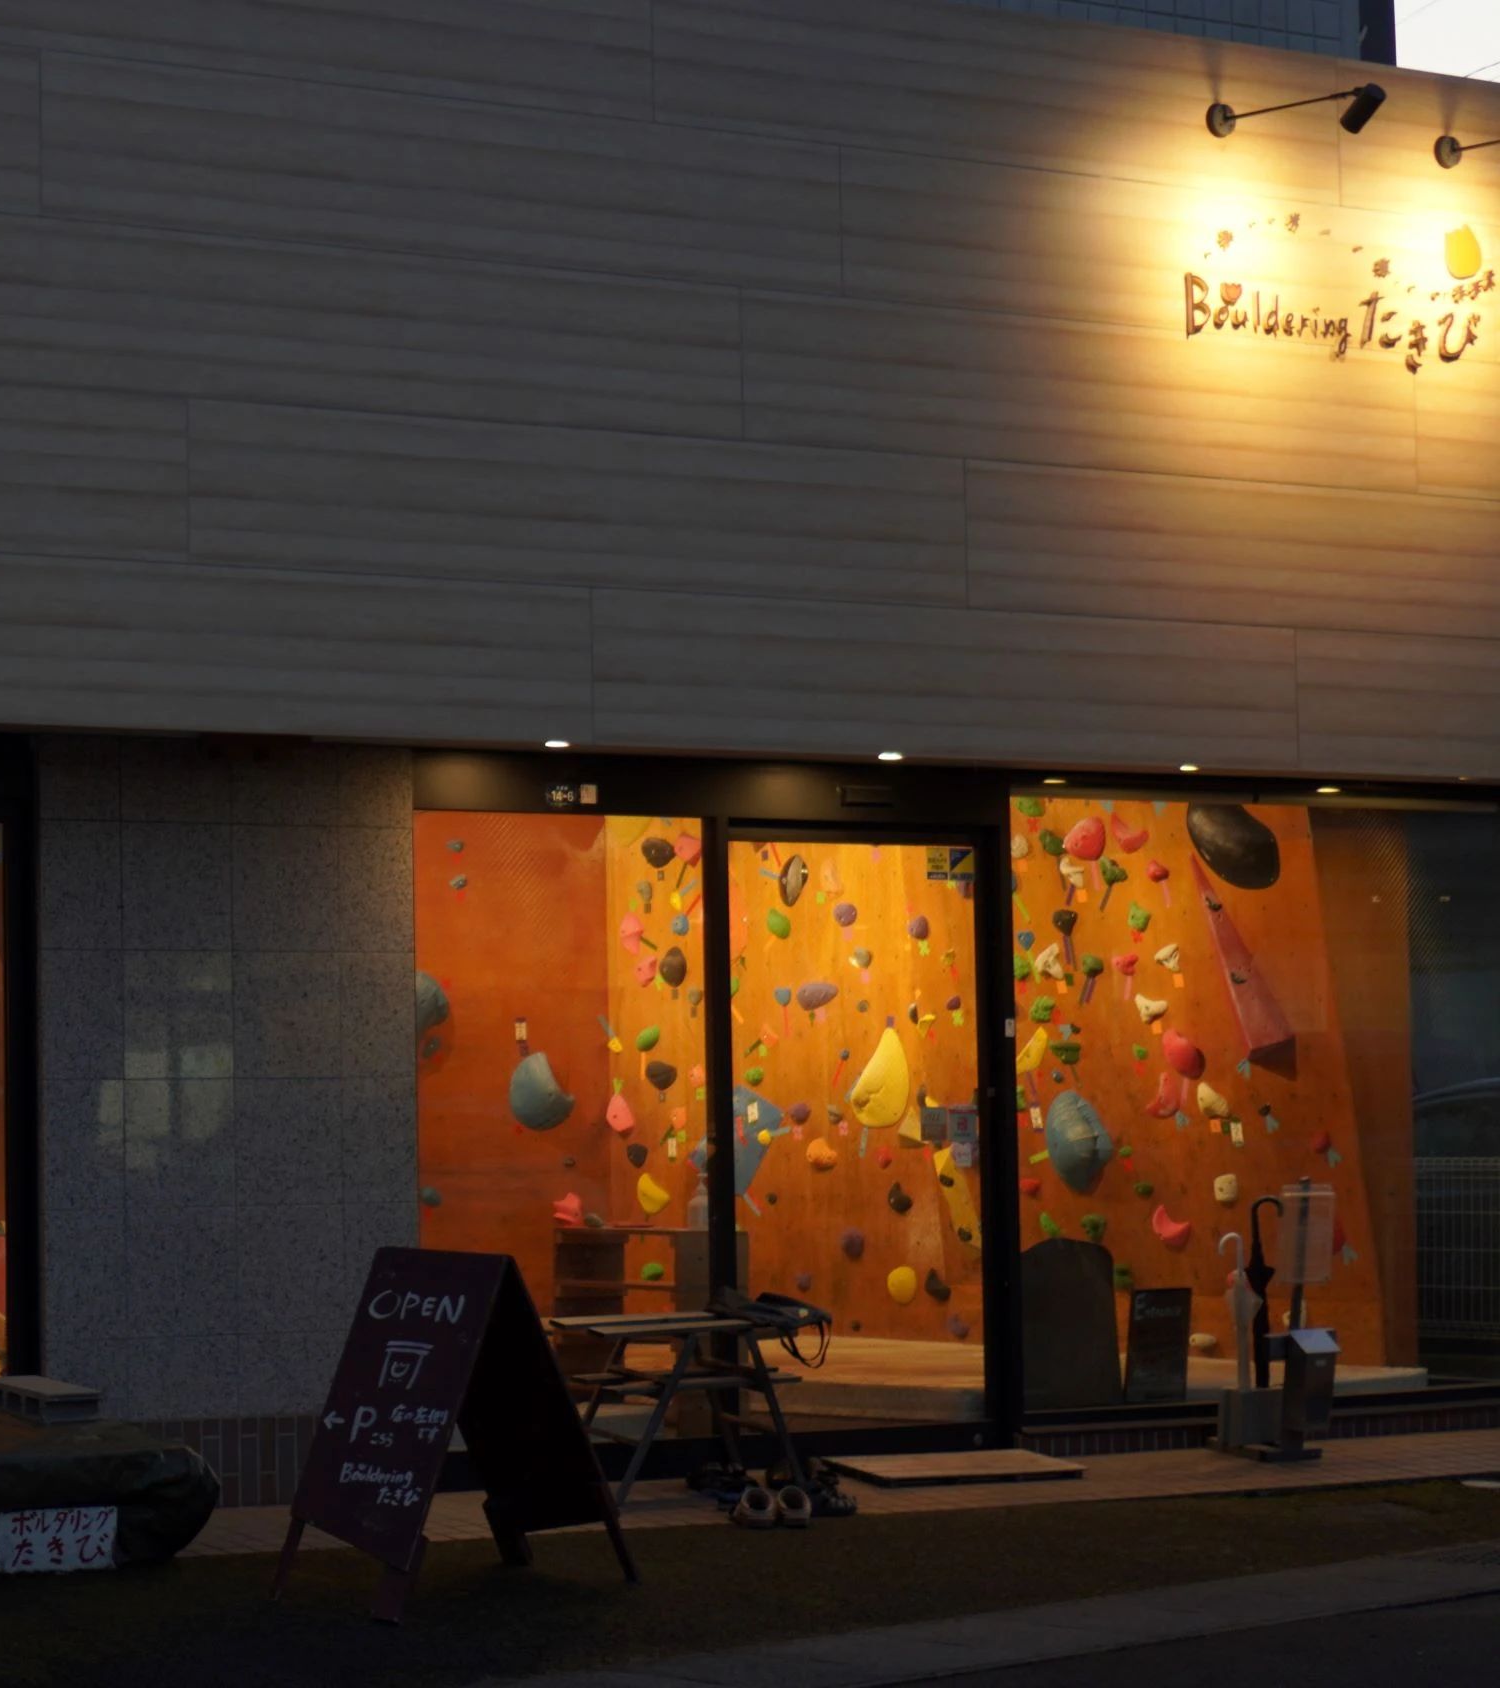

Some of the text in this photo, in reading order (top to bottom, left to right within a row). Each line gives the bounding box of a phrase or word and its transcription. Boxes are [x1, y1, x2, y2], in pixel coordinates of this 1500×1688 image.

[1184, 272, 1481, 375] Bouldering たきび
[368, 1289, 466, 1324] OPEN
[349, 1405, 378, 1444] P
[339, 1460, 414, 1488] Bouldering
[376, 1486, 423, 1507] たきび
[11, 1508, 115, 1536] ボルダリング
[11, 1533, 109, 1567] たきび
